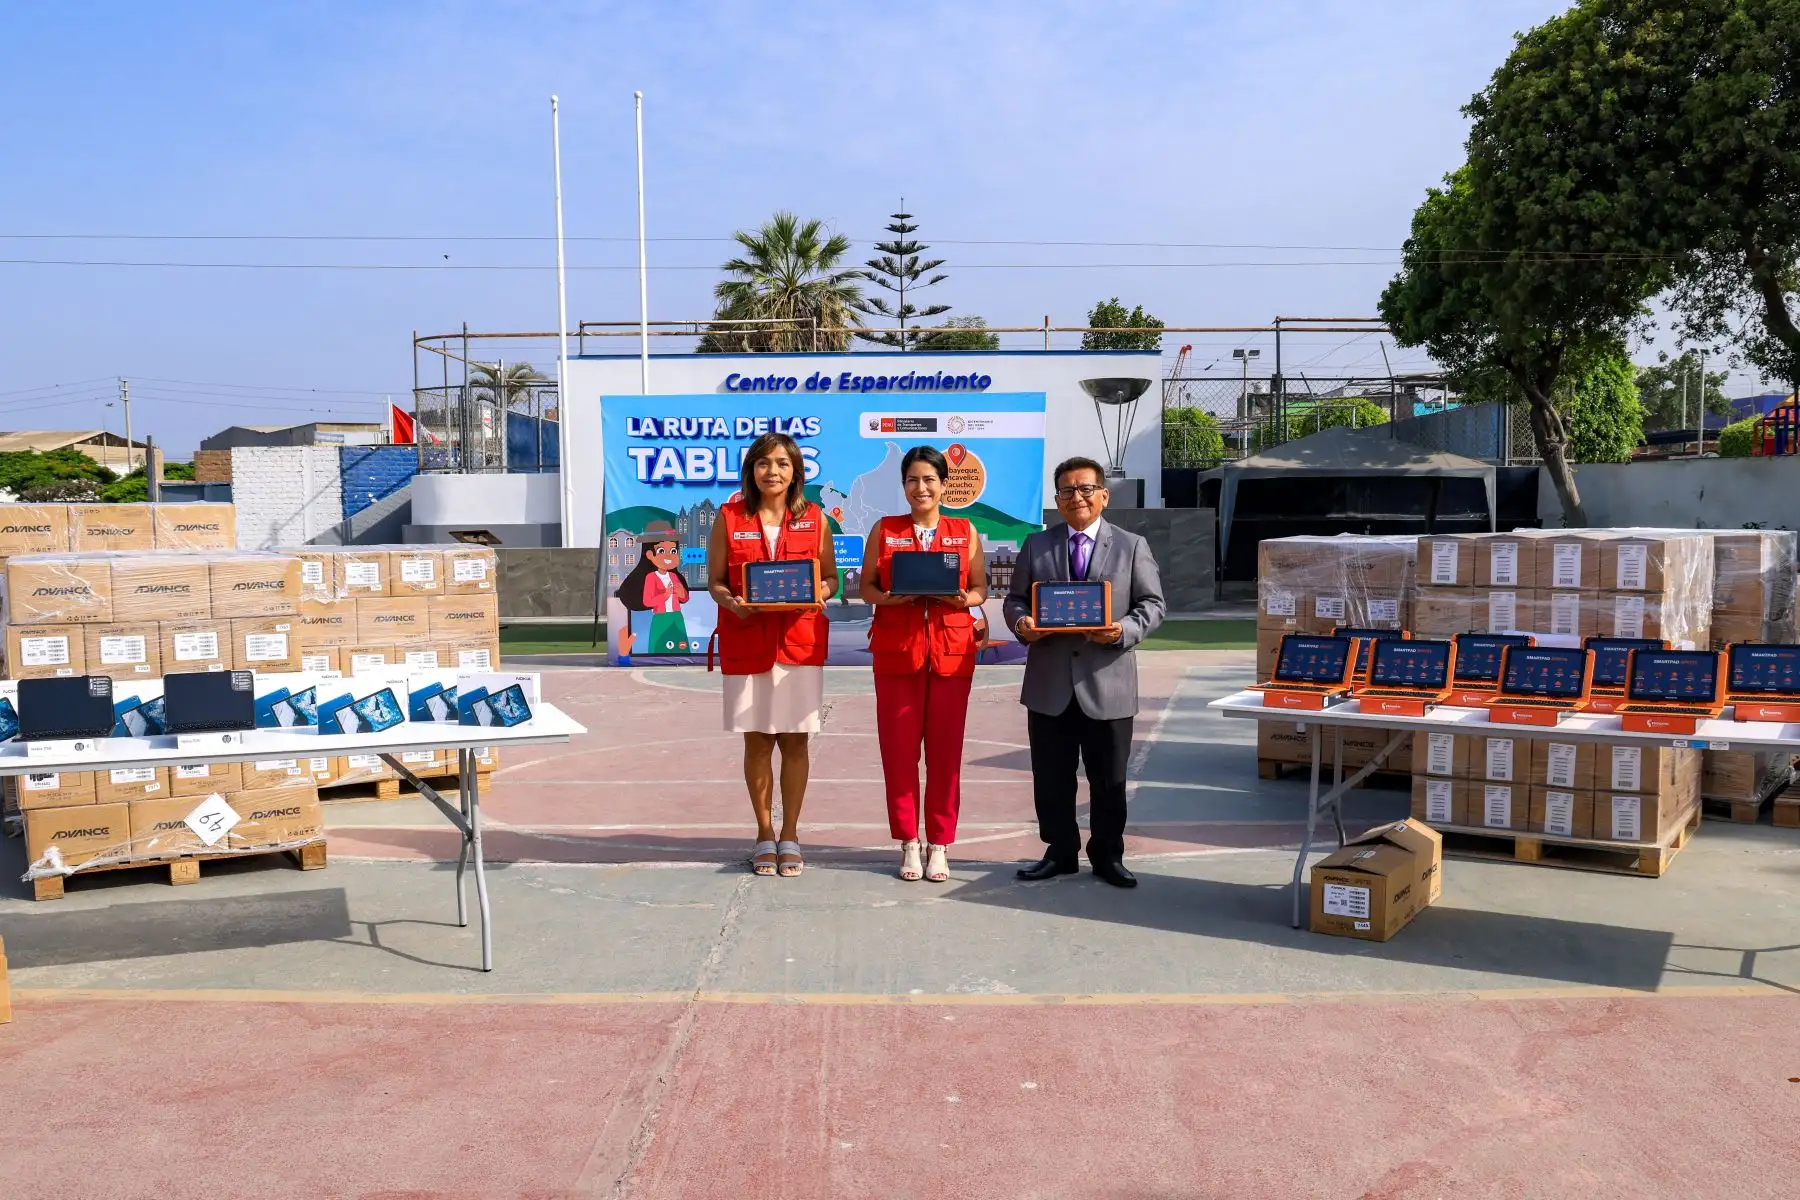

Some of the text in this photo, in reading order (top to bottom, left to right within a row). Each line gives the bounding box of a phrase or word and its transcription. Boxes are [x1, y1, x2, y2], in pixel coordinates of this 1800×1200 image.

[725, 370, 992, 394] Centro de Esparcimiento
[626, 416, 821, 438] LA RUTA DE LAS
[628, 446, 820, 484] TABLS
[949, 467, 980, 475] bayeque,
[0, 525, 51, 534] ADVANCE
[173, 523, 220, 532] ADVANCE
[134, 585, 191, 594] ADVANCE
[232, 580, 285, 591] ADVANCE
[373, 614, 415, 623] ADVANCE
[444, 611, 485, 620] ADVANCE
[249, 807, 301, 820] ADVANCE
[51, 827, 110, 840] ADVANCE
